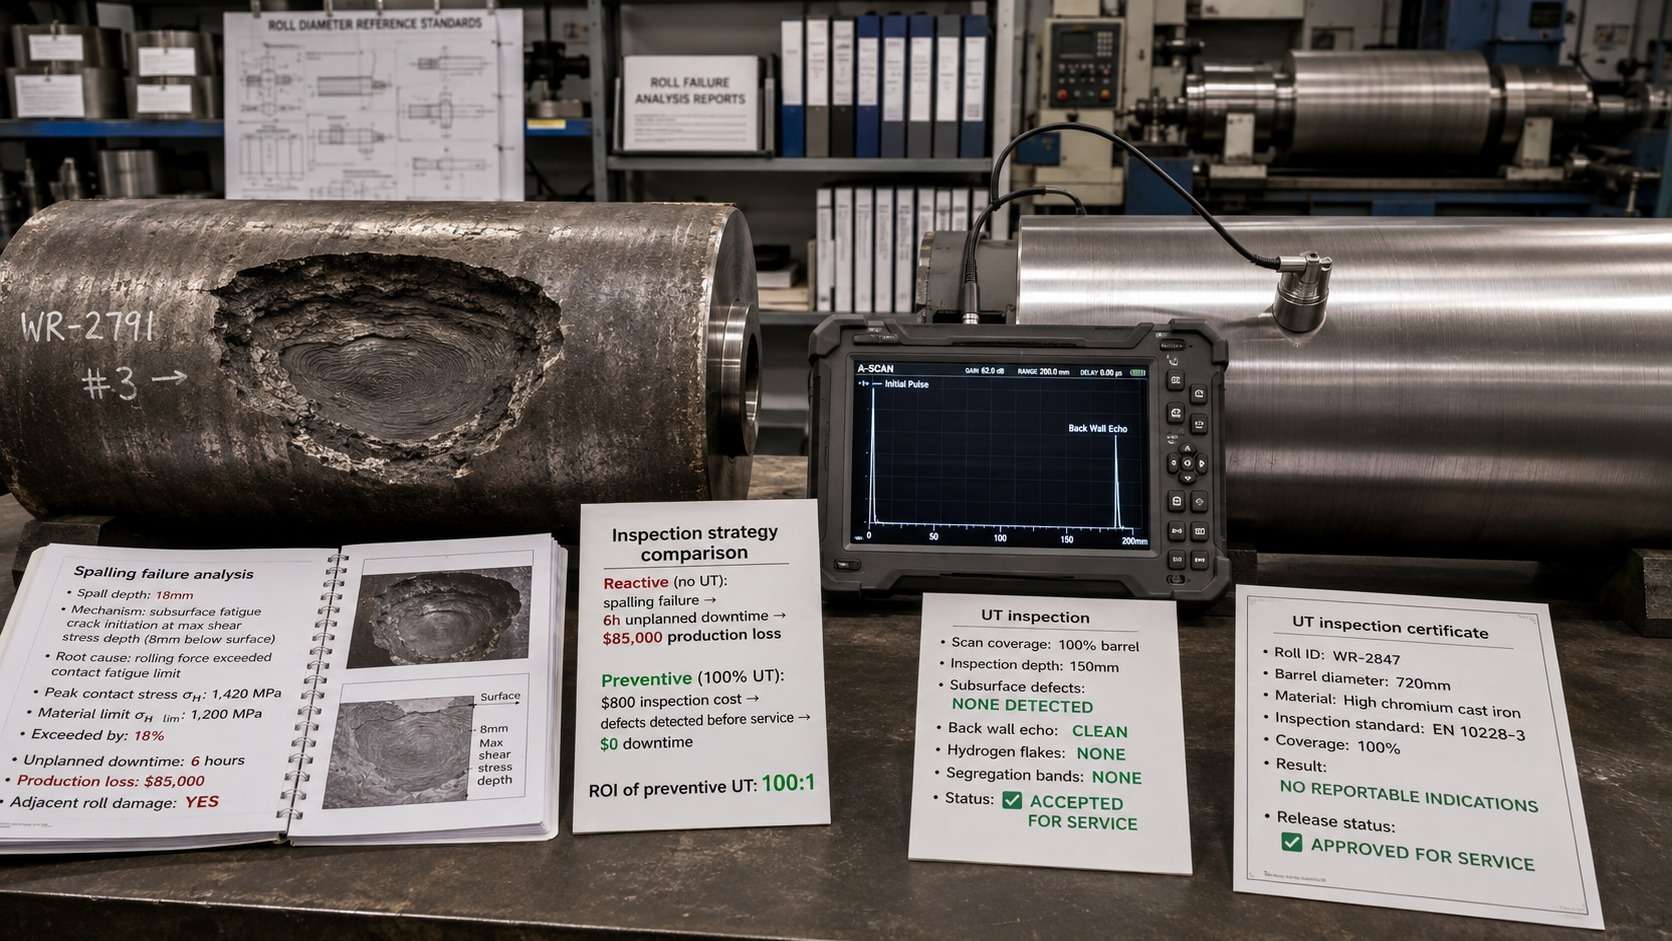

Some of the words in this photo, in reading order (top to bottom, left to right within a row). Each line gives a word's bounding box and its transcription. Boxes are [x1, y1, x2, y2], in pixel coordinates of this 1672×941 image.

[268, 20, 296, 32] ROLL
[299, 19, 353, 31] DIAMETER
[356, 19, 417, 30] REFERENCE
[421, 18, 482, 29] STANDARDS
[650, 77, 680, 88] ROLL
[683, 77, 730, 88] FAILURE
[635, 93, 690, 104] ANALYSIS
[693, 93, 746, 104] REPORTS
[21, 310, 153, 342] WR-2791
[858, 364, 894, 373] A-SCAN
[885, 379, 906, 388] Initial
[908, 380, 929, 388] Pulse
[1069, 424, 1088, 432] Back
[1089, 424, 1107, 432] Wall
[1108, 424, 1128, 433] Echo
[613, 526, 702, 545] Inspection
[708, 526, 778, 541] strategy
[866, 531, 872, 539] 0
[929, 532, 939, 541] 50
[994, 534, 1007, 542] 100
[1061, 535, 1074, 543] 150
[1122, 537, 1148, 545] 200mm
[641, 545, 748, 564] comparison
[74, 565, 137, 581] Spalling
[141, 568, 189, 580] failure
[194, 569, 254, 582] analysis
[604, 576, 669, 589] Reactive
[674, 576, 695, 589] (no
[700, 574, 727, 588] UT):
[77, 588, 108, 599] Spall
[111, 590, 151, 601] depth:
[157, 591, 193, 600] 18mm
[603, 596, 654, 611] spalling
[658, 595, 699, 606] failure
[71, 605, 146, 616] Mechanism:
[149, 607, 216, 616] subsurface
[220, 607, 262, 618] fatigue
[603, 614, 620, 626] 6h
[626, 611, 697, 627] unplanned
[701, 610, 769, 623] downtime
[982, 609, 1003, 621] UT
[1008, 610, 1090, 625] inspection
[1293, 615, 1315, 627] UT
[1320, 617, 1401, 633] inspection
[1407, 624, 1489, 639] certificate
[62, 633, 100, 642] stress
[103, 634, 140, 645] depth
[144, 634, 180, 645] (8mm
[184, 634, 223, 644] below
[226, 634, 275, 645] surface)
[603, 631, 663, 646] $85,000
[668, 629, 747, 646] production
[753, 628, 781, 640] loss
[952, 636, 983, 648] Scan
[987, 640, 1051, 652] coverage:
[1059, 640, 1097, 651] 100%
[1101, 640, 1139, 652] barrel
[56, 651, 87, 662] Root
[90, 655, 131, 663] cause:
[135, 653, 174, 665] rolling
[178, 653, 209, 663] force
[213, 652, 272, 663] exceeded
[1275, 647, 1301, 659] Roll
[1306, 649, 1325, 660] ID:
[1333, 651, 1400, 665] WR-2847
[951, 658, 1017, 671] Inspection
[1021, 659, 1063, 673] depth:
[1070, 661, 1119, 673] 150mm
[602, 672, 692, 687] Preventive
[698, 670, 747, 687] (100%
[753, 668, 784, 684] UT):
[1275, 668, 1317, 682] Barrel
[1321, 672, 1388, 687] diameter:
[1396, 677, 1451, 691] 720mm
[950, 679, 1026, 692] Subsurface
[1031, 681, 1085, 694] defects:
[481, 691, 521, 701] Surface
[601, 696, 635, 710] $800
[640, 694, 709, 710] inspection
[713, 694, 742, 705] cost
[952, 698, 999, 711] NONE
[1005, 699, 1093, 713] DETECTED
[1276, 689, 1336, 704] Material:
[1344, 694, 1376, 710] High
[1381, 698, 1453, 713] chromium
[1458, 705, 1488, 716] cast
[1492, 705, 1521, 719] iron
[480, 725, 508, 734] 8mm
[949, 722, 982, 734] Back
[987, 723, 1015, 735] wall
[1019, 724, 1058, 736] echo:
[1072, 725, 1127, 738] CLEAN
[1276, 712, 1350, 728] Inspection
[1355, 719, 1424, 734] standard:
[1433, 723, 1454, 736] EN
[31, 728, 103, 741] Exceeded
[106, 730, 128, 743] by:
[135, 730, 165, 741] 18%
[480, 739, 503, 747] Max
[1276, 734, 1349, 752] Coverage:
[1358, 740, 1400, 755] 100%
[479, 750, 511, 760] shear
[948, 744, 1015, 760] Hydrogen
[1020, 745, 1065, 759] flakes:
[1077, 747, 1126, 761] NONE
[24, 754, 105, 768] Unplanned
[108, 756, 184, 767] downtime:
[191, 756, 200, 767] 6
[204, 755, 245, 766] hours
[478, 764, 513, 773] stress
[1276, 757, 1326, 773] Result:
[17, 774, 100, 787] Production
[105, 776, 139, 787] loss:
[144, 775, 205, 788] $85,000
[477, 775, 512, 787] depth
[946, 766, 1031, 783] Segregation
[1036, 769, 1084, 782] bands:
[1092, 771, 1142, 785] NONE
[589, 783, 617, 798] ROI
[623, 782, 640, 796] of
[644, 780, 727, 800] preventive
[732, 779, 757, 793] UT:
[762, 773, 814, 792] 100:1
[10, 796, 79, 810] Adjacent
[83, 797, 108, 809] roll
[112, 797, 177, 811] damage:
[186, 795, 219, 808] YES
[945, 792, 994, 805] Status:
[1030, 795, 1123, 810] ACCEPTED
[1280, 780, 1306, 793] NO
[1311, 782, 1420, 803] REPORTABLE
[1425, 792, 1539, 813] INDICATIONS
[1028, 814, 1062, 828] FOR
[1067, 816, 1138, 831] SERVICE
[1277, 810, 1338, 828] Release
[1343, 818, 1395, 833] status:
[1311, 838, 1409, 859] APPROVED
[1415, 848, 1452, 864] FOR
[1458, 852, 1535, 872] SERVICE
